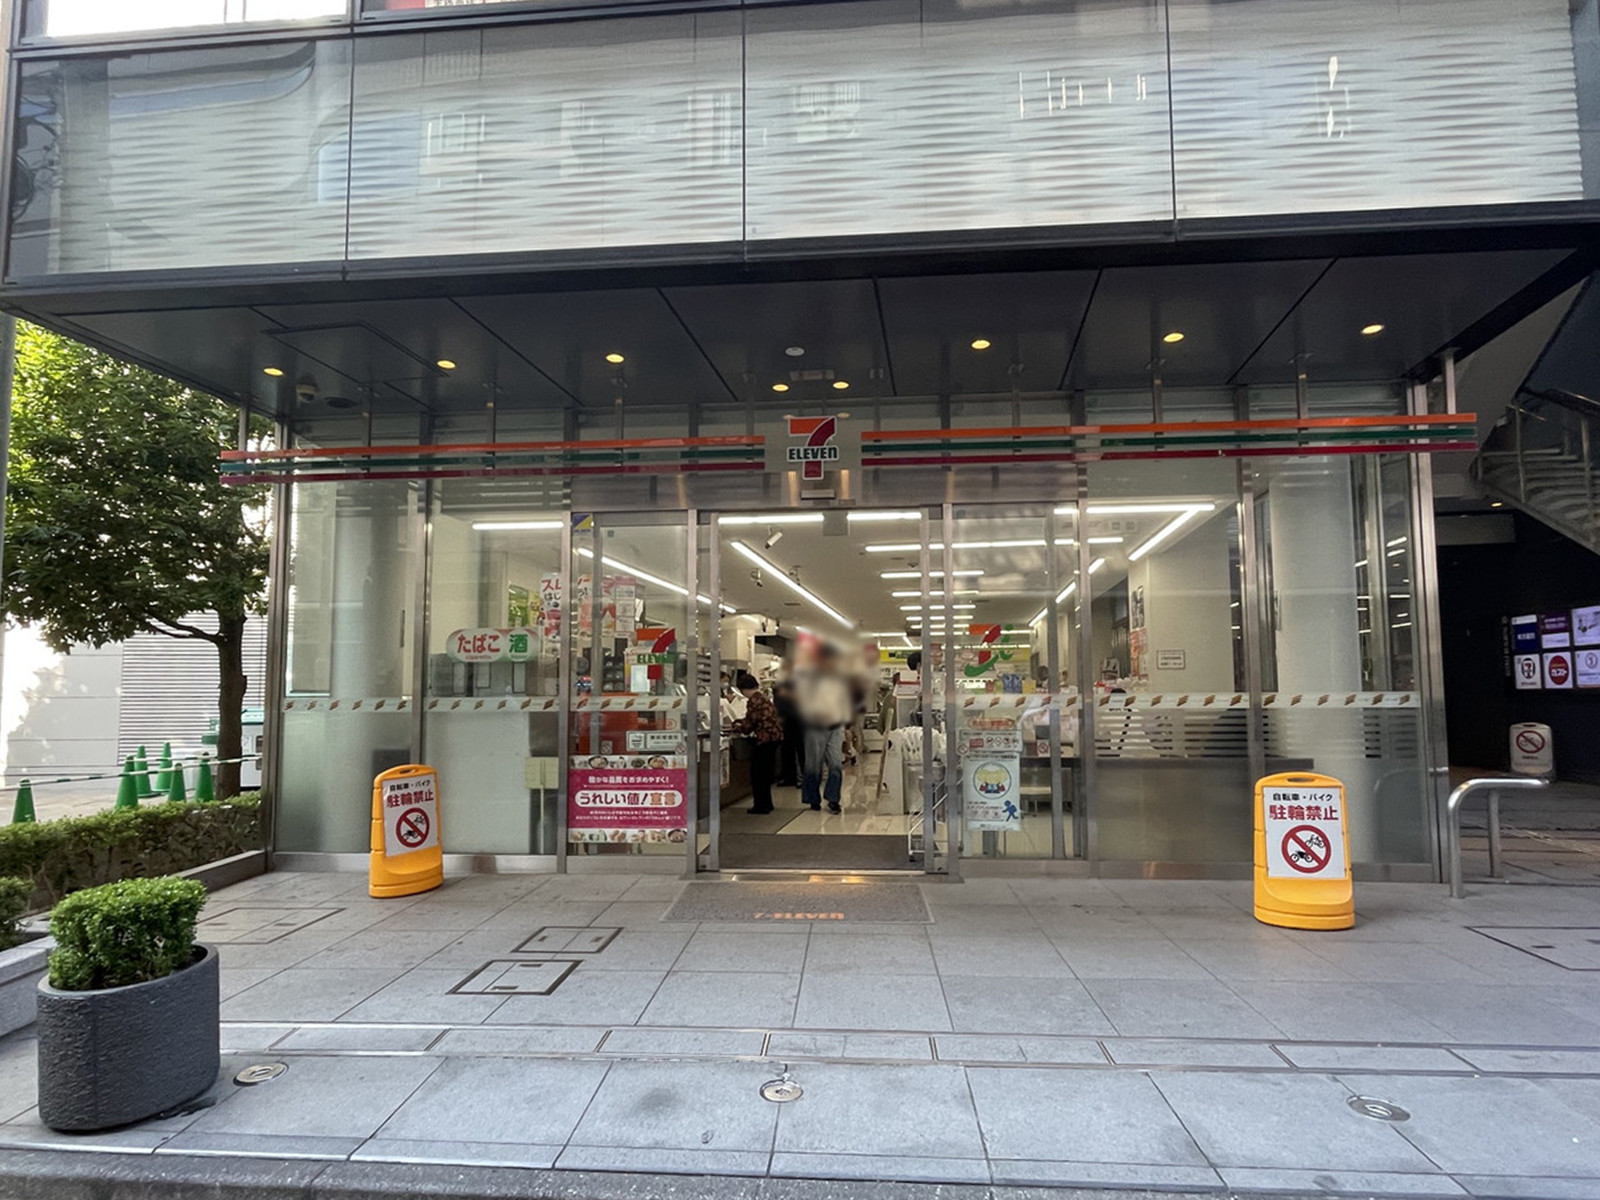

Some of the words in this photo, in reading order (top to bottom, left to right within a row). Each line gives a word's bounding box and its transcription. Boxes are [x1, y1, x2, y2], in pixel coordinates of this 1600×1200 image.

[458, 634, 500, 653] たばこ
[509, 634, 528, 653] 酒
[387, 790, 434, 807] 駐輪禁止
[1273, 793, 1333, 801] 自転車・バイク
[1268, 805, 1339, 820] 駐輪禁止
